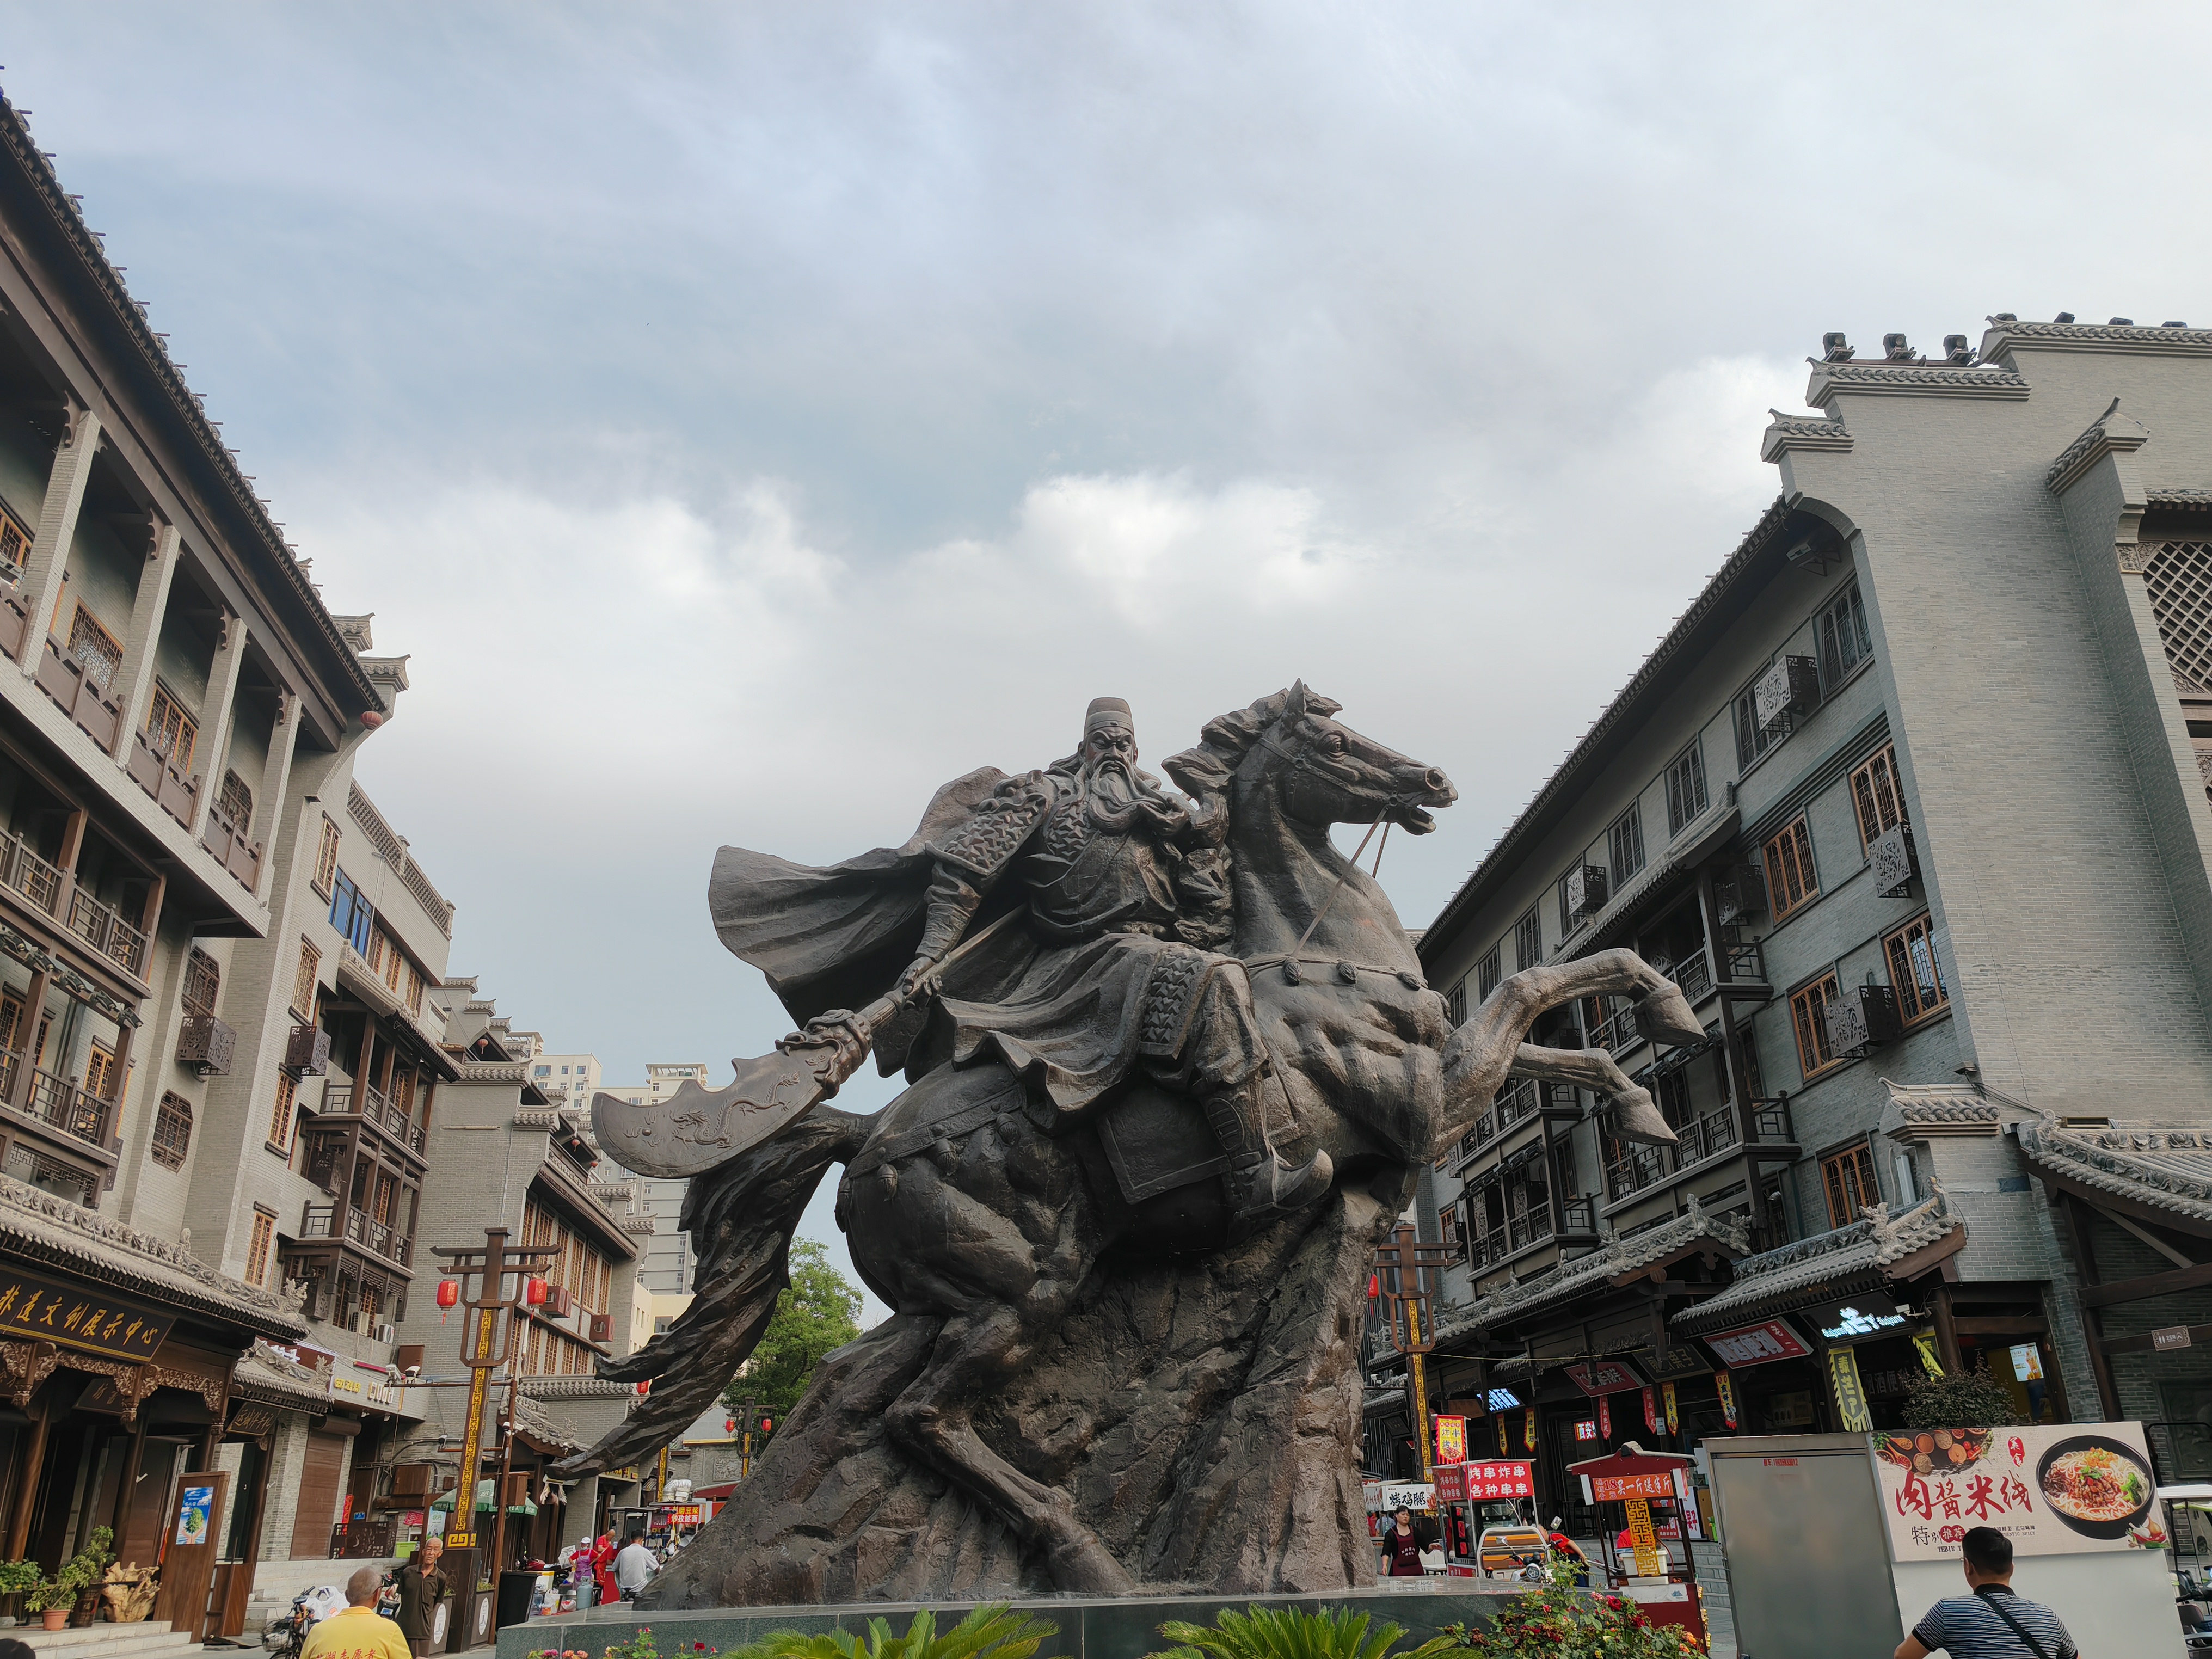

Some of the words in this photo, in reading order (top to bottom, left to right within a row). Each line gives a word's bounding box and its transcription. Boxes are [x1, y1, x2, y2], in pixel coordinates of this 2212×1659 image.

[1710, 1328, 1785, 1363] 烟酒便利
[1442, 1428, 1460, 1438] 炸串
[2010, 1437, 2023, 1466] 美食
[1469, 1465, 1526, 1479] 烤串炸串
[1471, 1483, 1528, 1497] 各种串串
[1606, 1479, 1618, 1490] 18
[1617, 1475, 1670, 1496] 买一斤送半斤
[1389, 1491, 1426, 1507] 烤鸡腿
[1609, 1491, 1617, 1500] 元
[1896, 1470, 2033, 1521] 肉酱米线
[1911, 1526, 1964, 1546] 特别推荐
